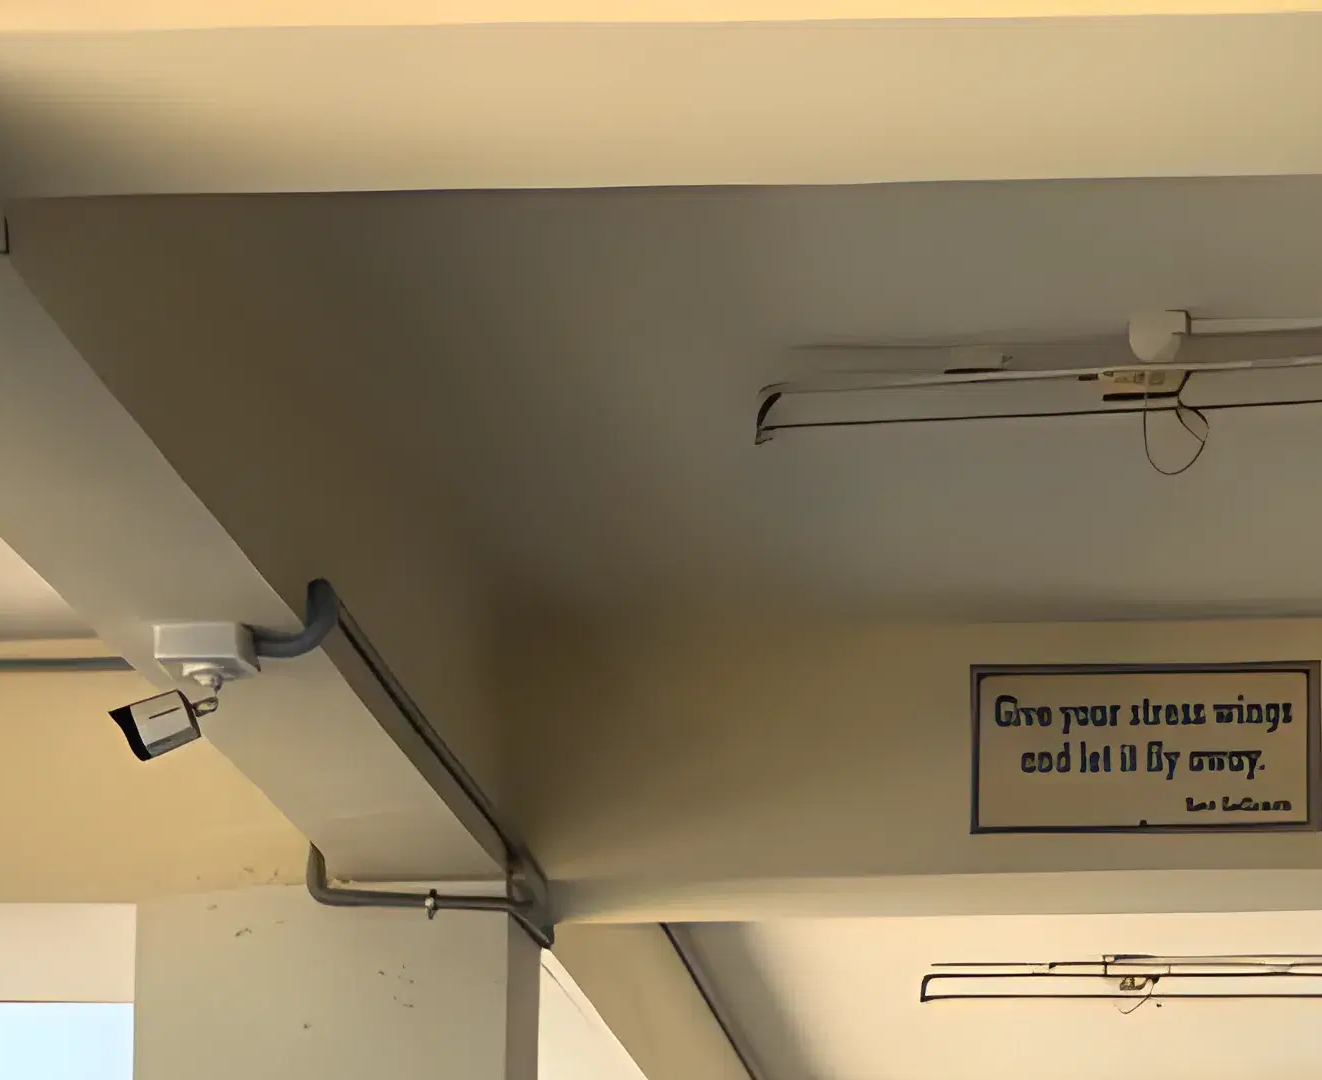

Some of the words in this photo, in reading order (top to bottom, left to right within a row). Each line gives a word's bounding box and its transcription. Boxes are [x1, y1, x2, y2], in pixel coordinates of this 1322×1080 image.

[1058, 704, 1121, 735] your
[1129, 698, 1207, 726] stress
[1212, 694, 1293, 734] wings
